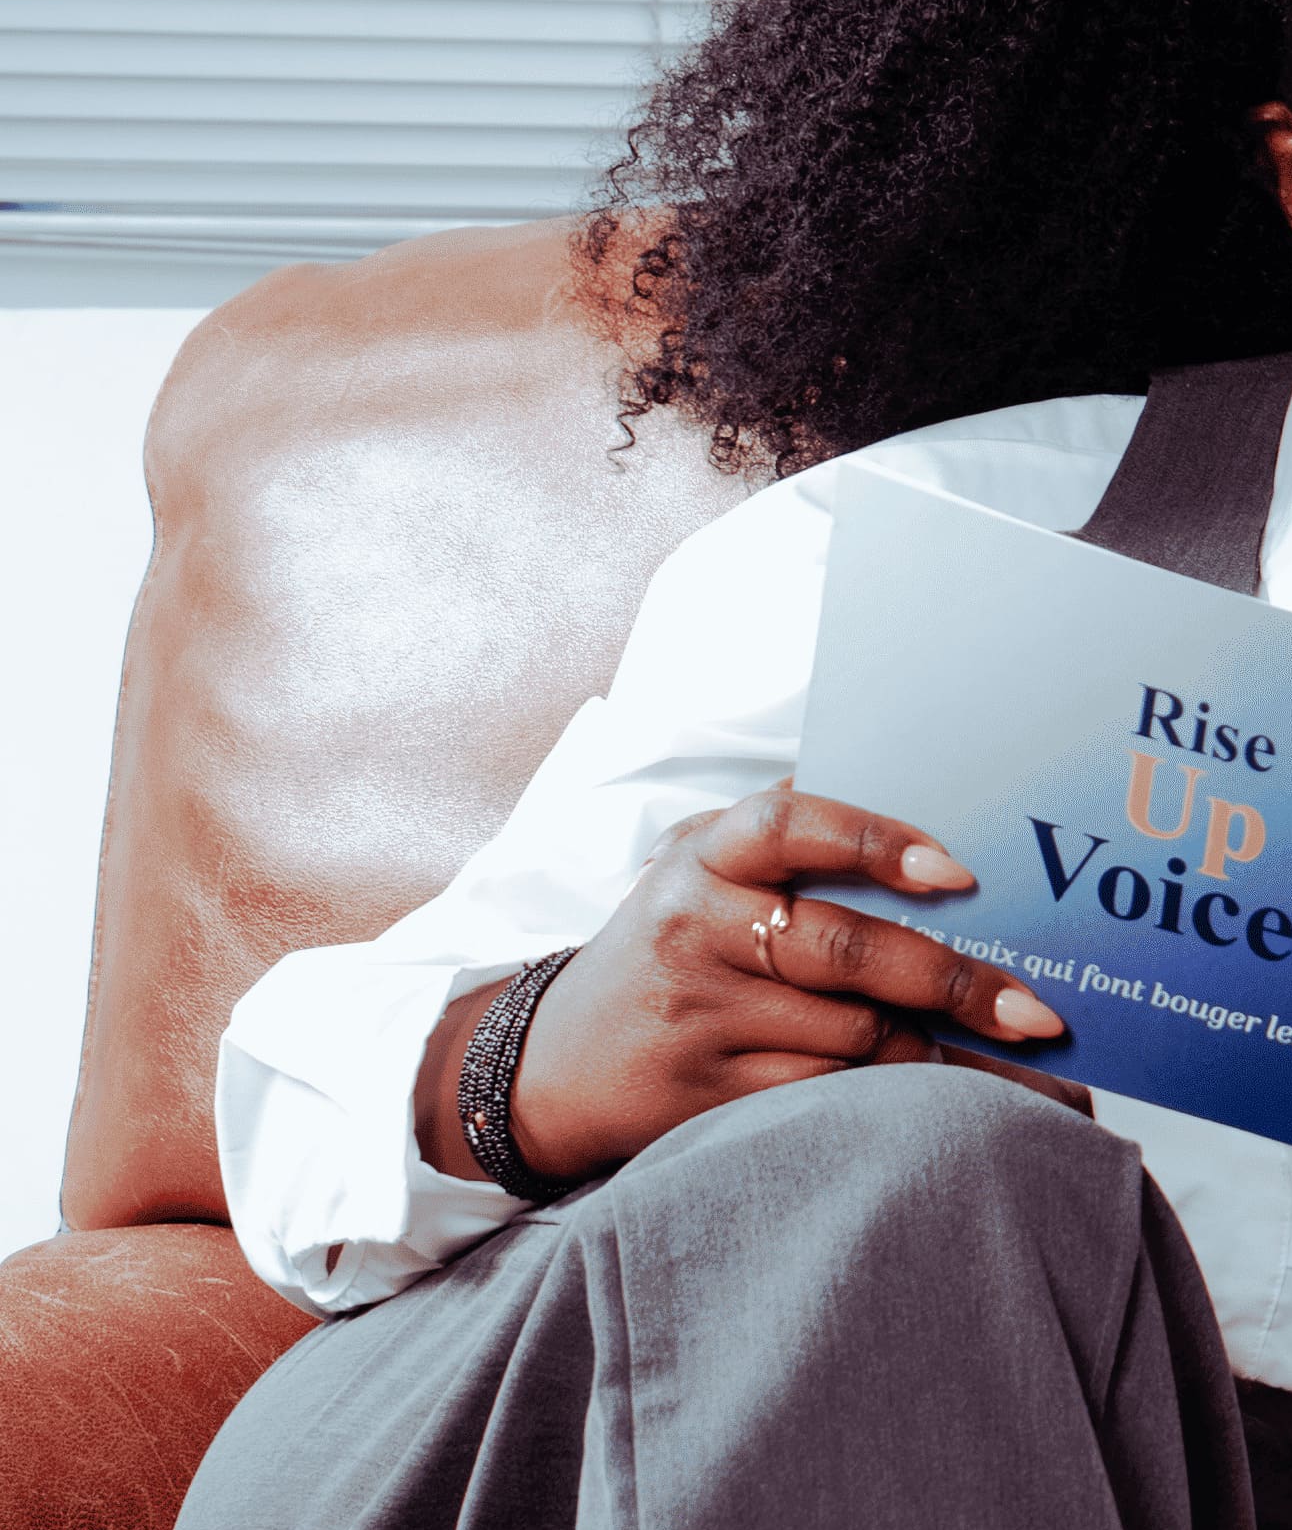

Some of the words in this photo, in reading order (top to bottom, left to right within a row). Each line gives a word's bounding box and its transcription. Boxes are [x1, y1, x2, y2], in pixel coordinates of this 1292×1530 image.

[1132, 682, 1276, 772] Rise
[1126, 749, 1267, 881] Up
[952, 935, 1019, 968] voix
[1023, 954, 1076, 980] qui
[1078, 963, 1147, 1001] font
[1150, 982, 1262, 1032] bouger
